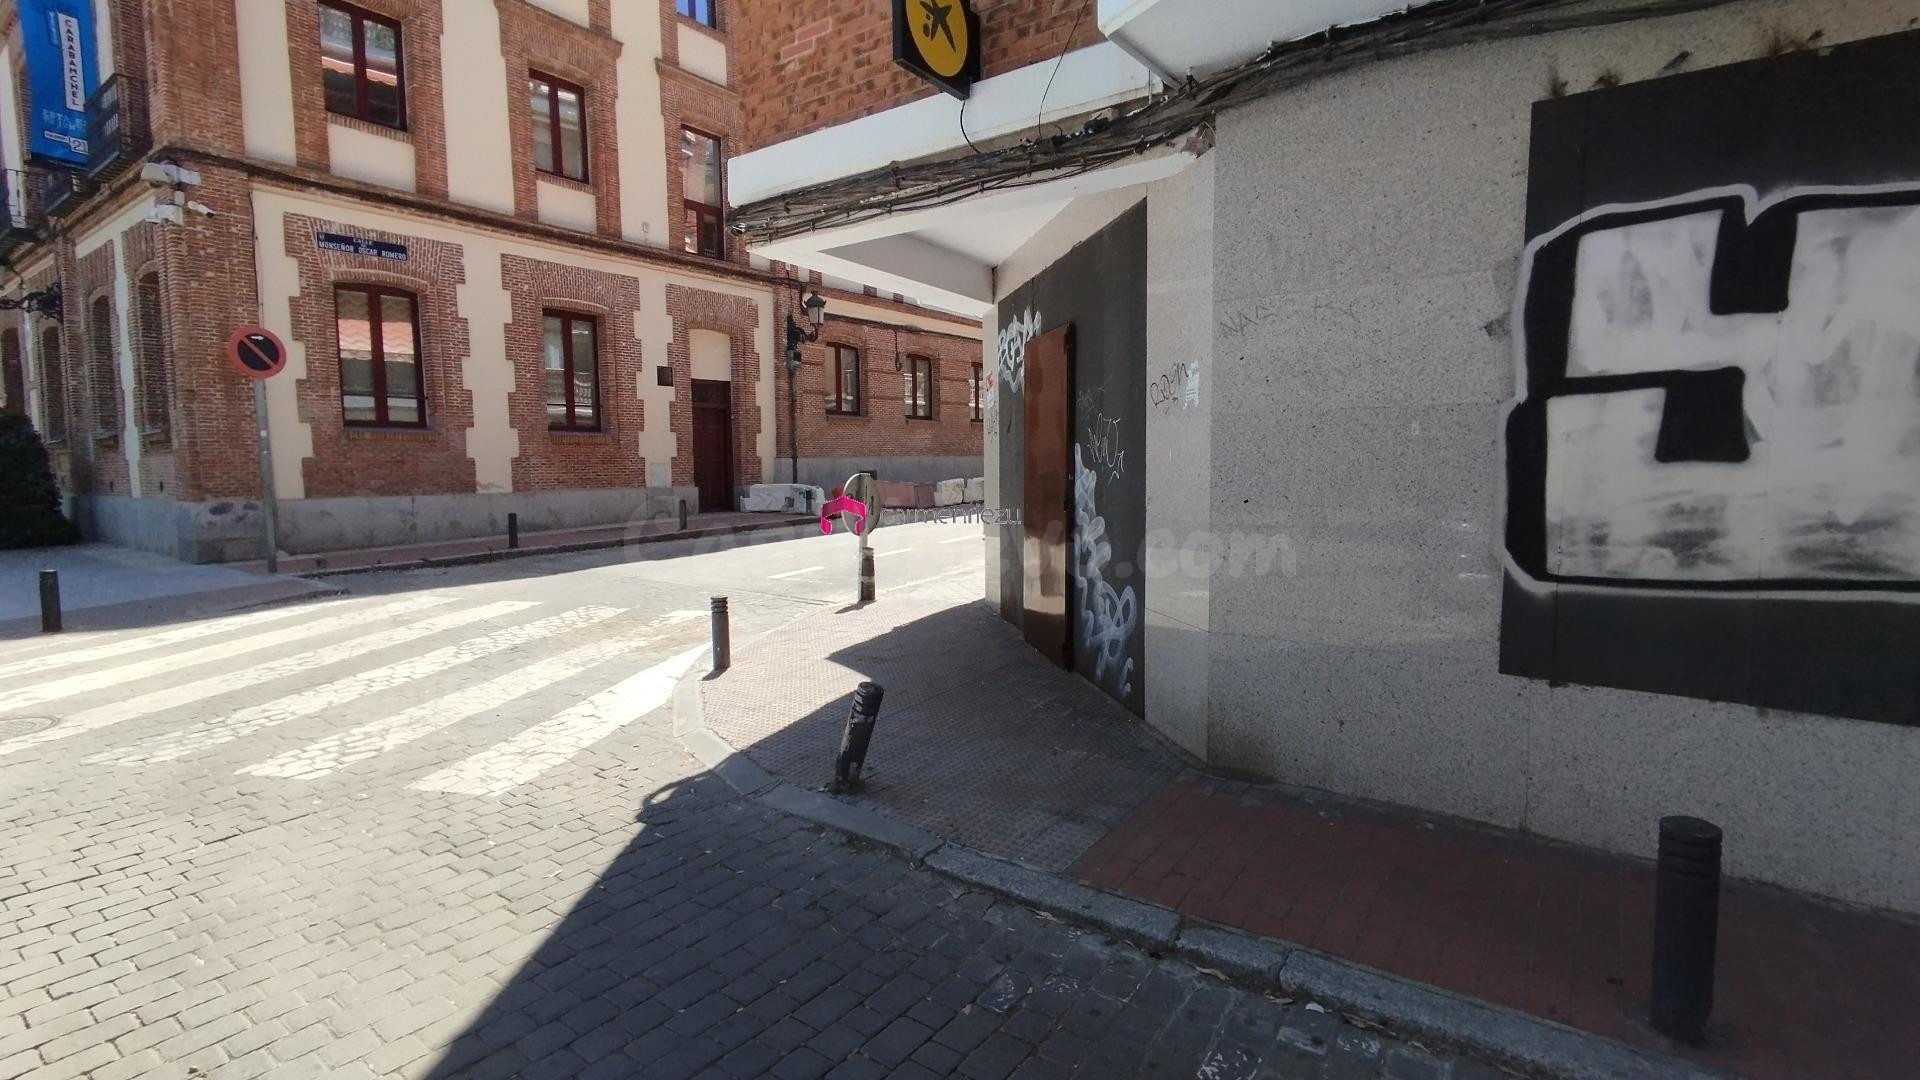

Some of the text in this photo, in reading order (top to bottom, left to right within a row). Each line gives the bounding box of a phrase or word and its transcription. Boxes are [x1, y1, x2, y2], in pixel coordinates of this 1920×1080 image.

[65, 19, 79, 106] CARABANCHEL
[318, 240, 355, 252] MONSEÑOR
[381, 250, 407, 260] ROMERO
